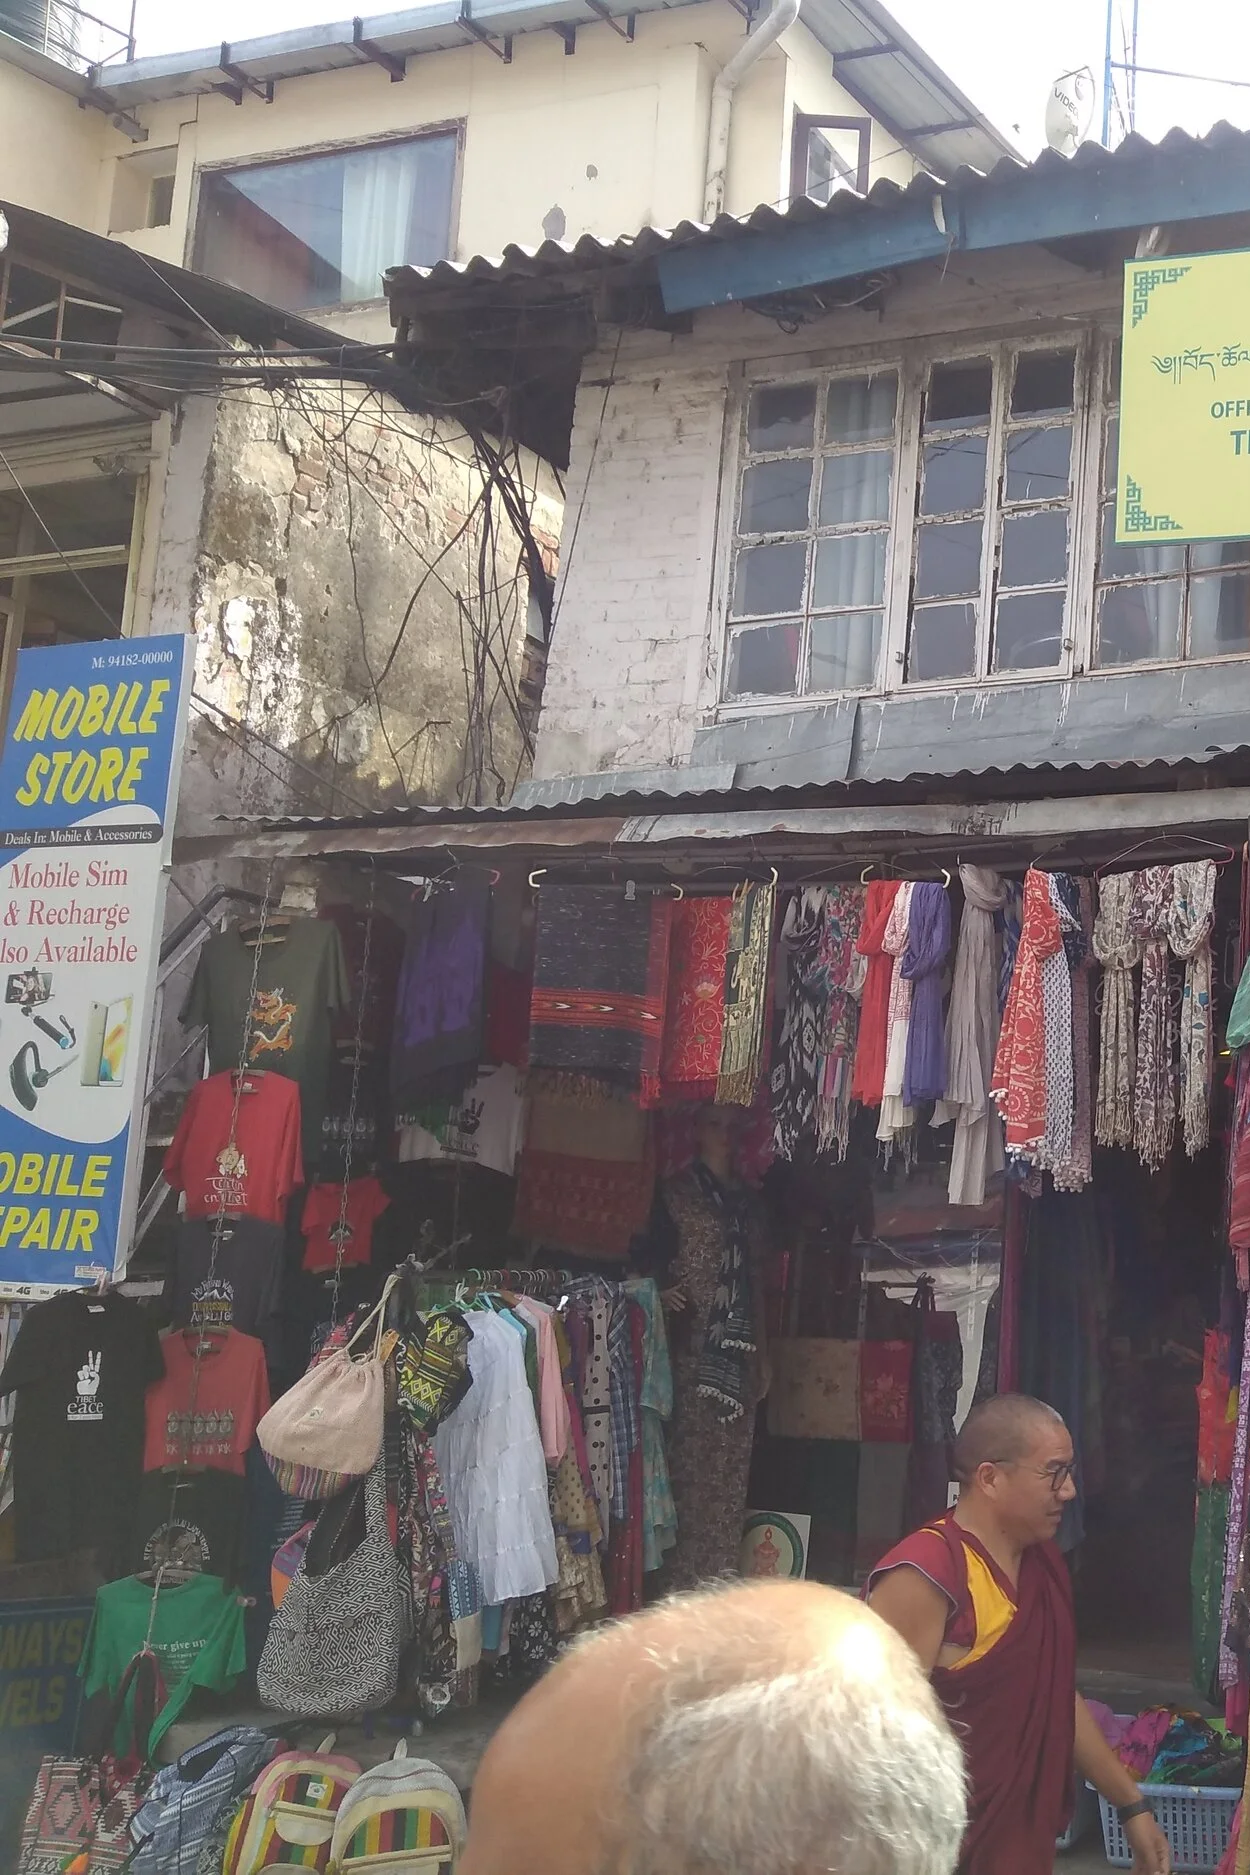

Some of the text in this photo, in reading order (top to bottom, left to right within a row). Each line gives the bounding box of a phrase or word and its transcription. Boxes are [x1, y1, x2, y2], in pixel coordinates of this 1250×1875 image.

[92, 650, 173, 669] M: 94182-00000
[13, 679, 170, 742] MOBILE
[15, 747, 149, 806] STORE
[5, 832, 32, 845] Deals
[49, 830, 82, 843] Mobile
[84, 830, 92, 841] &
[94, 828, 153, 841] Accessories
[9, 860, 128, 889] Mobile Sim
[3, 899, 130, 931] & Recharge
[35, 937, 138, 963] Available
[16, 1286, 31, 1295] 4G
[170, 1641, 190, 1653] give
